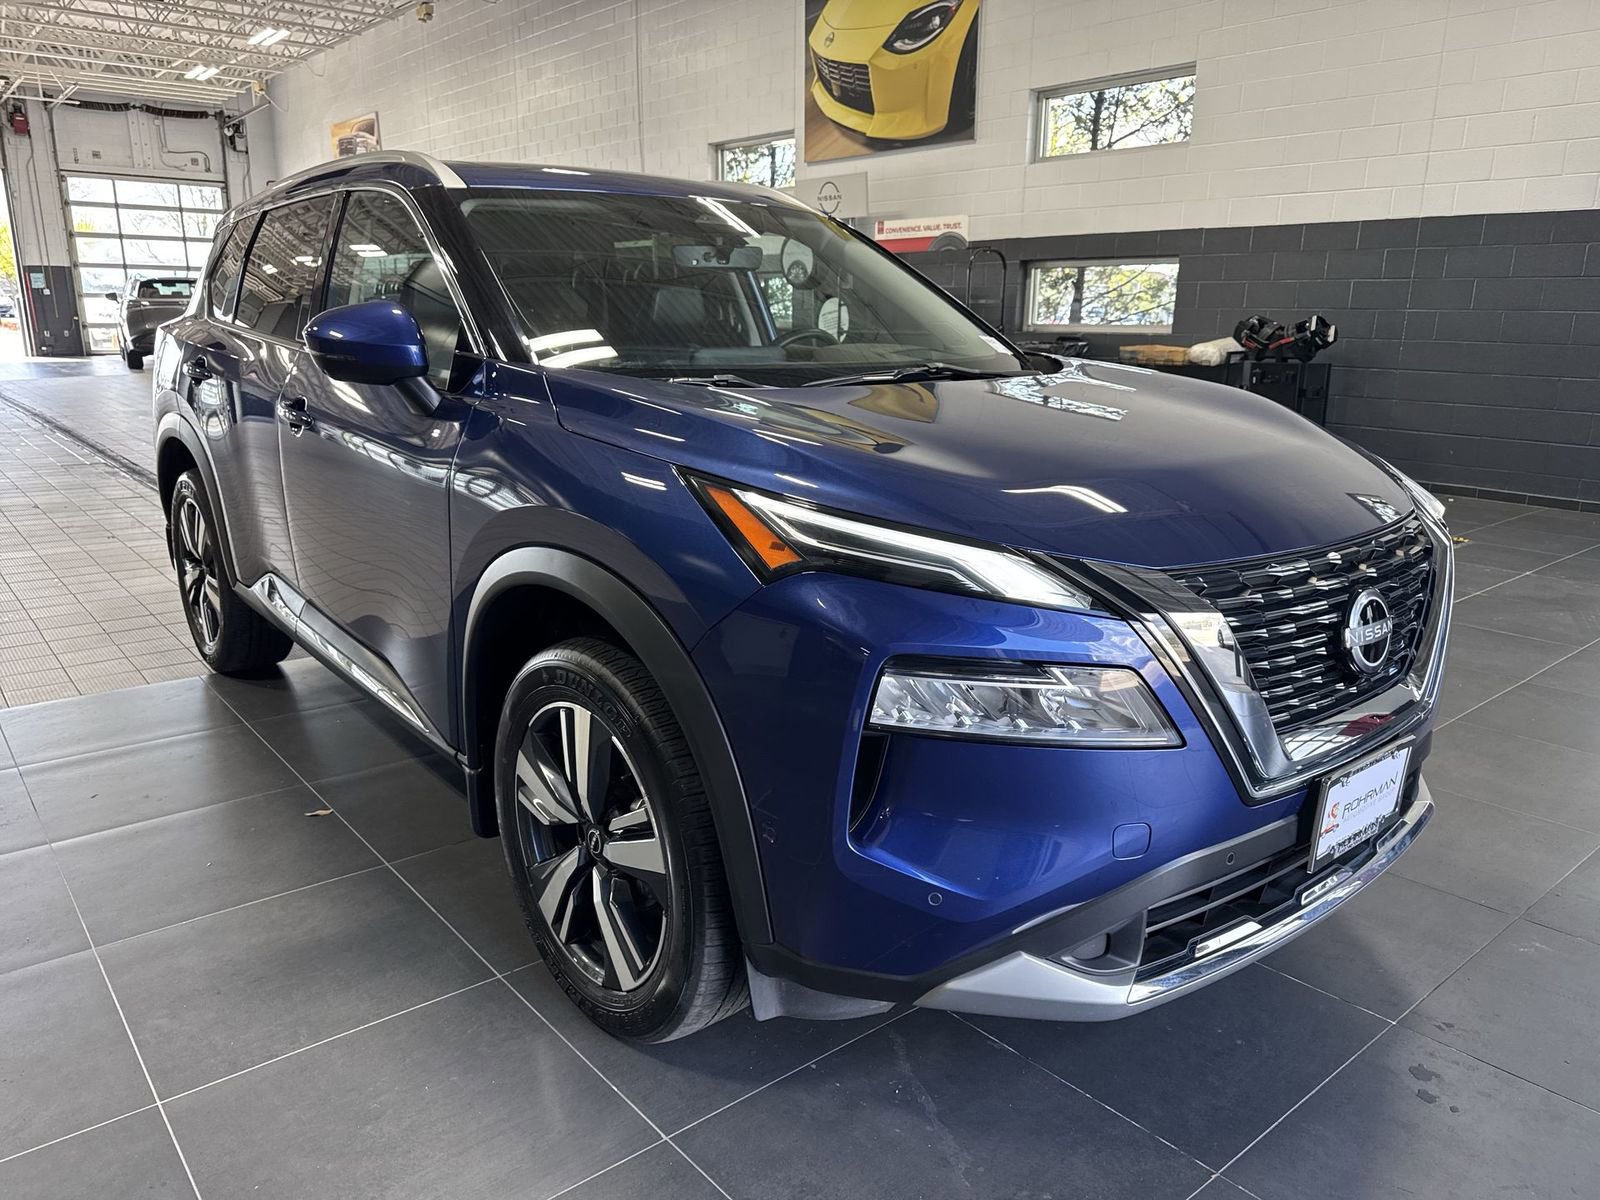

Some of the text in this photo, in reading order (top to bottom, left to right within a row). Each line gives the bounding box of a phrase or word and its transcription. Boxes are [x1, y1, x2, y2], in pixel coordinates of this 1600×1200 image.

[817, 194, 842, 202] NISSAN
[1349, 619, 1392, 643] NISSAN
[1341, 771, 1399, 819] ROHRMAN
